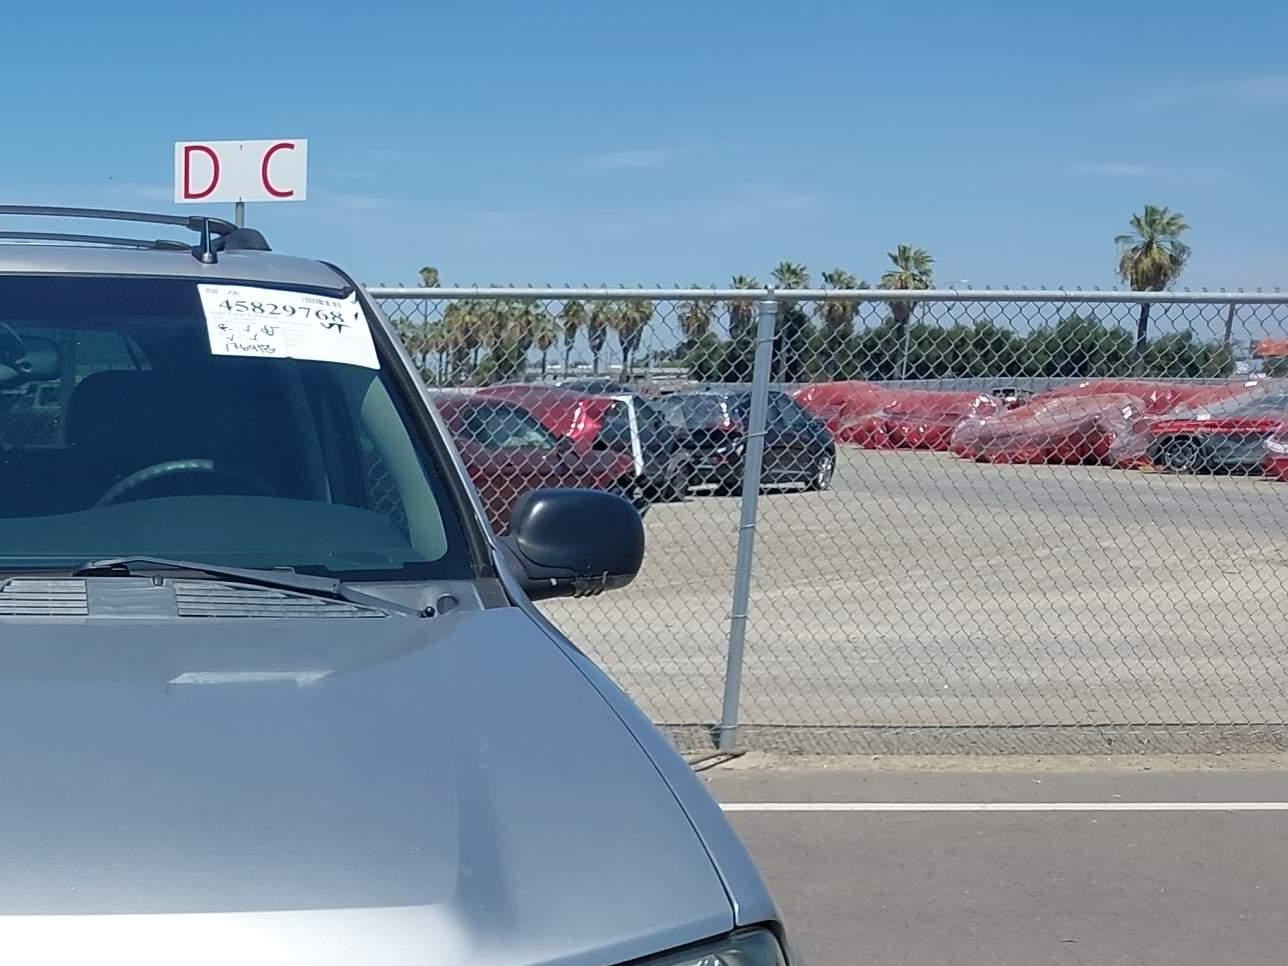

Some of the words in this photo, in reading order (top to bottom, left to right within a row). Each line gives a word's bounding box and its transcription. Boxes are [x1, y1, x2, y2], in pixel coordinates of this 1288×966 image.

[184, 145, 220, 199] D
[261, 142, 295, 198] C
[218, 299, 345, 323] 45829768
